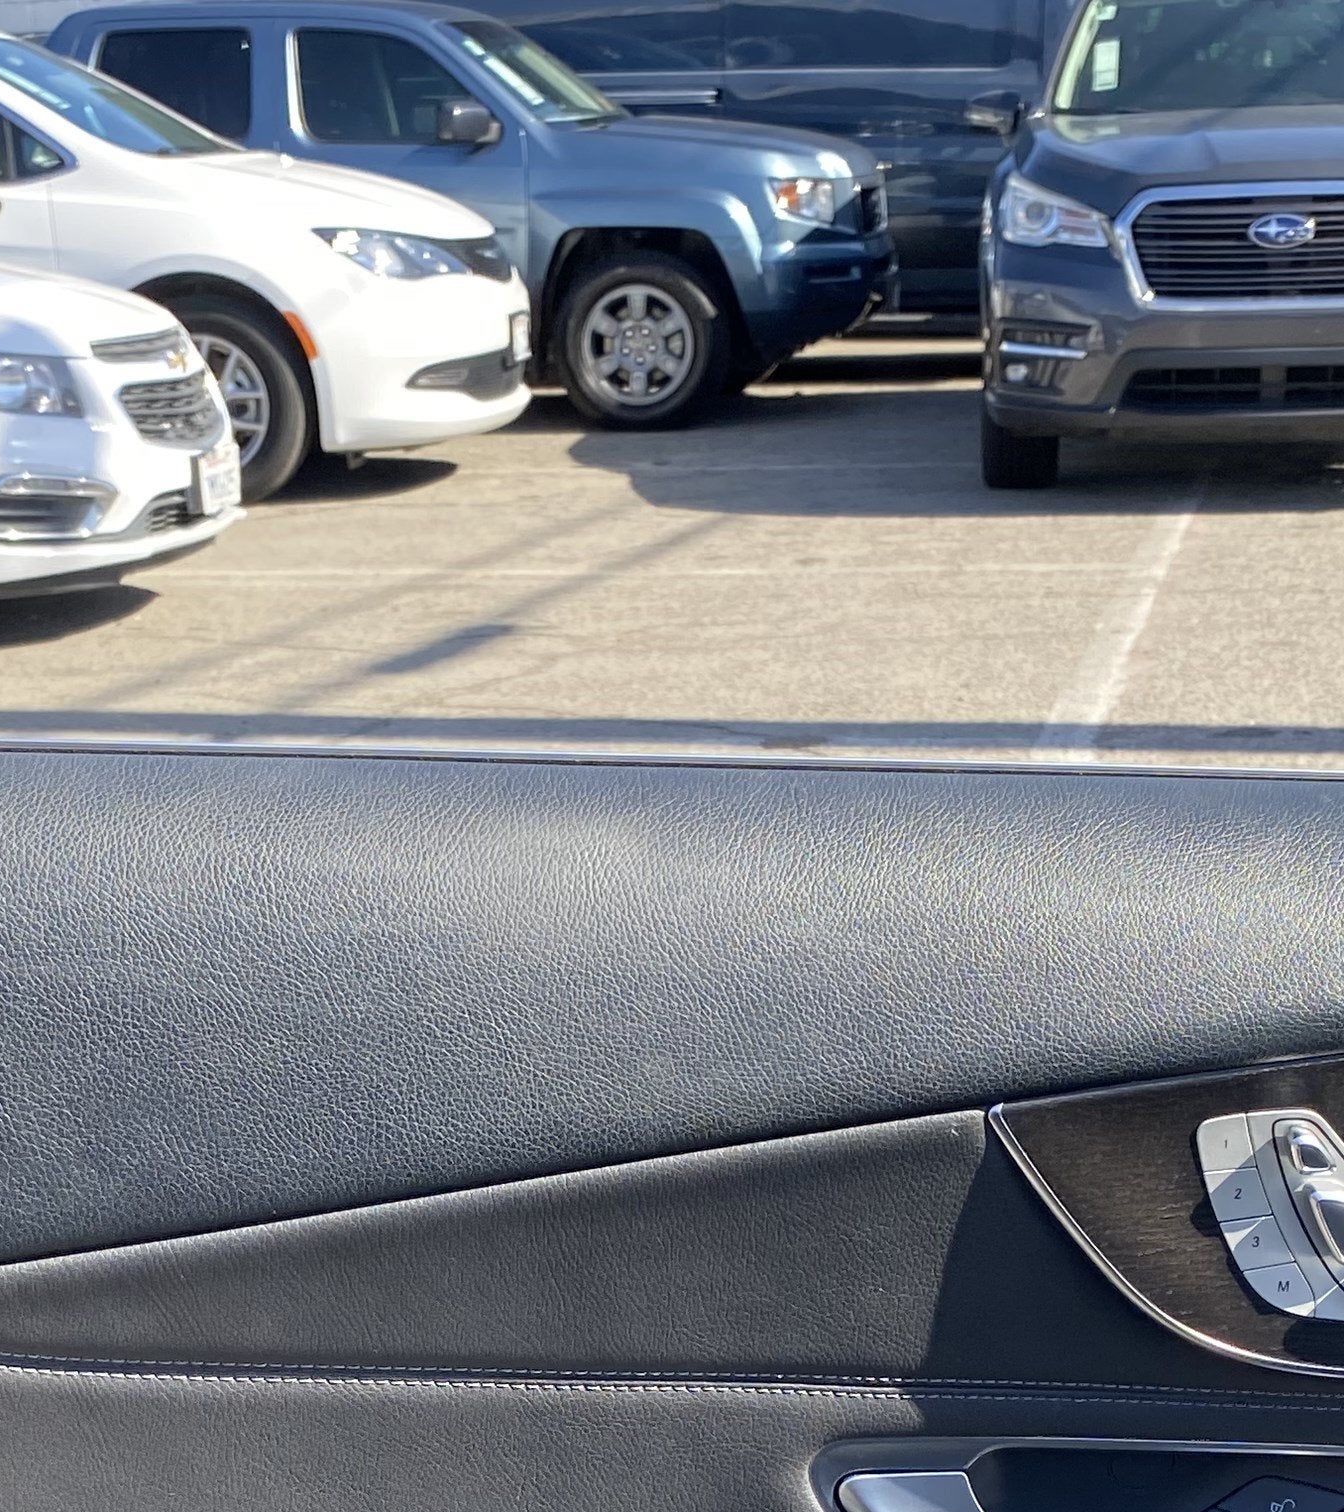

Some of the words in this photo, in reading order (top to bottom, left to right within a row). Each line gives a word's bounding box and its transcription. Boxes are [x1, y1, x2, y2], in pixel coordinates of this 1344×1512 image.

[1234, 1188, 1242, 1200] 2
[1252, 1236, 1260, 1248] 3
[1277, 1280, 1290, 1292] M
